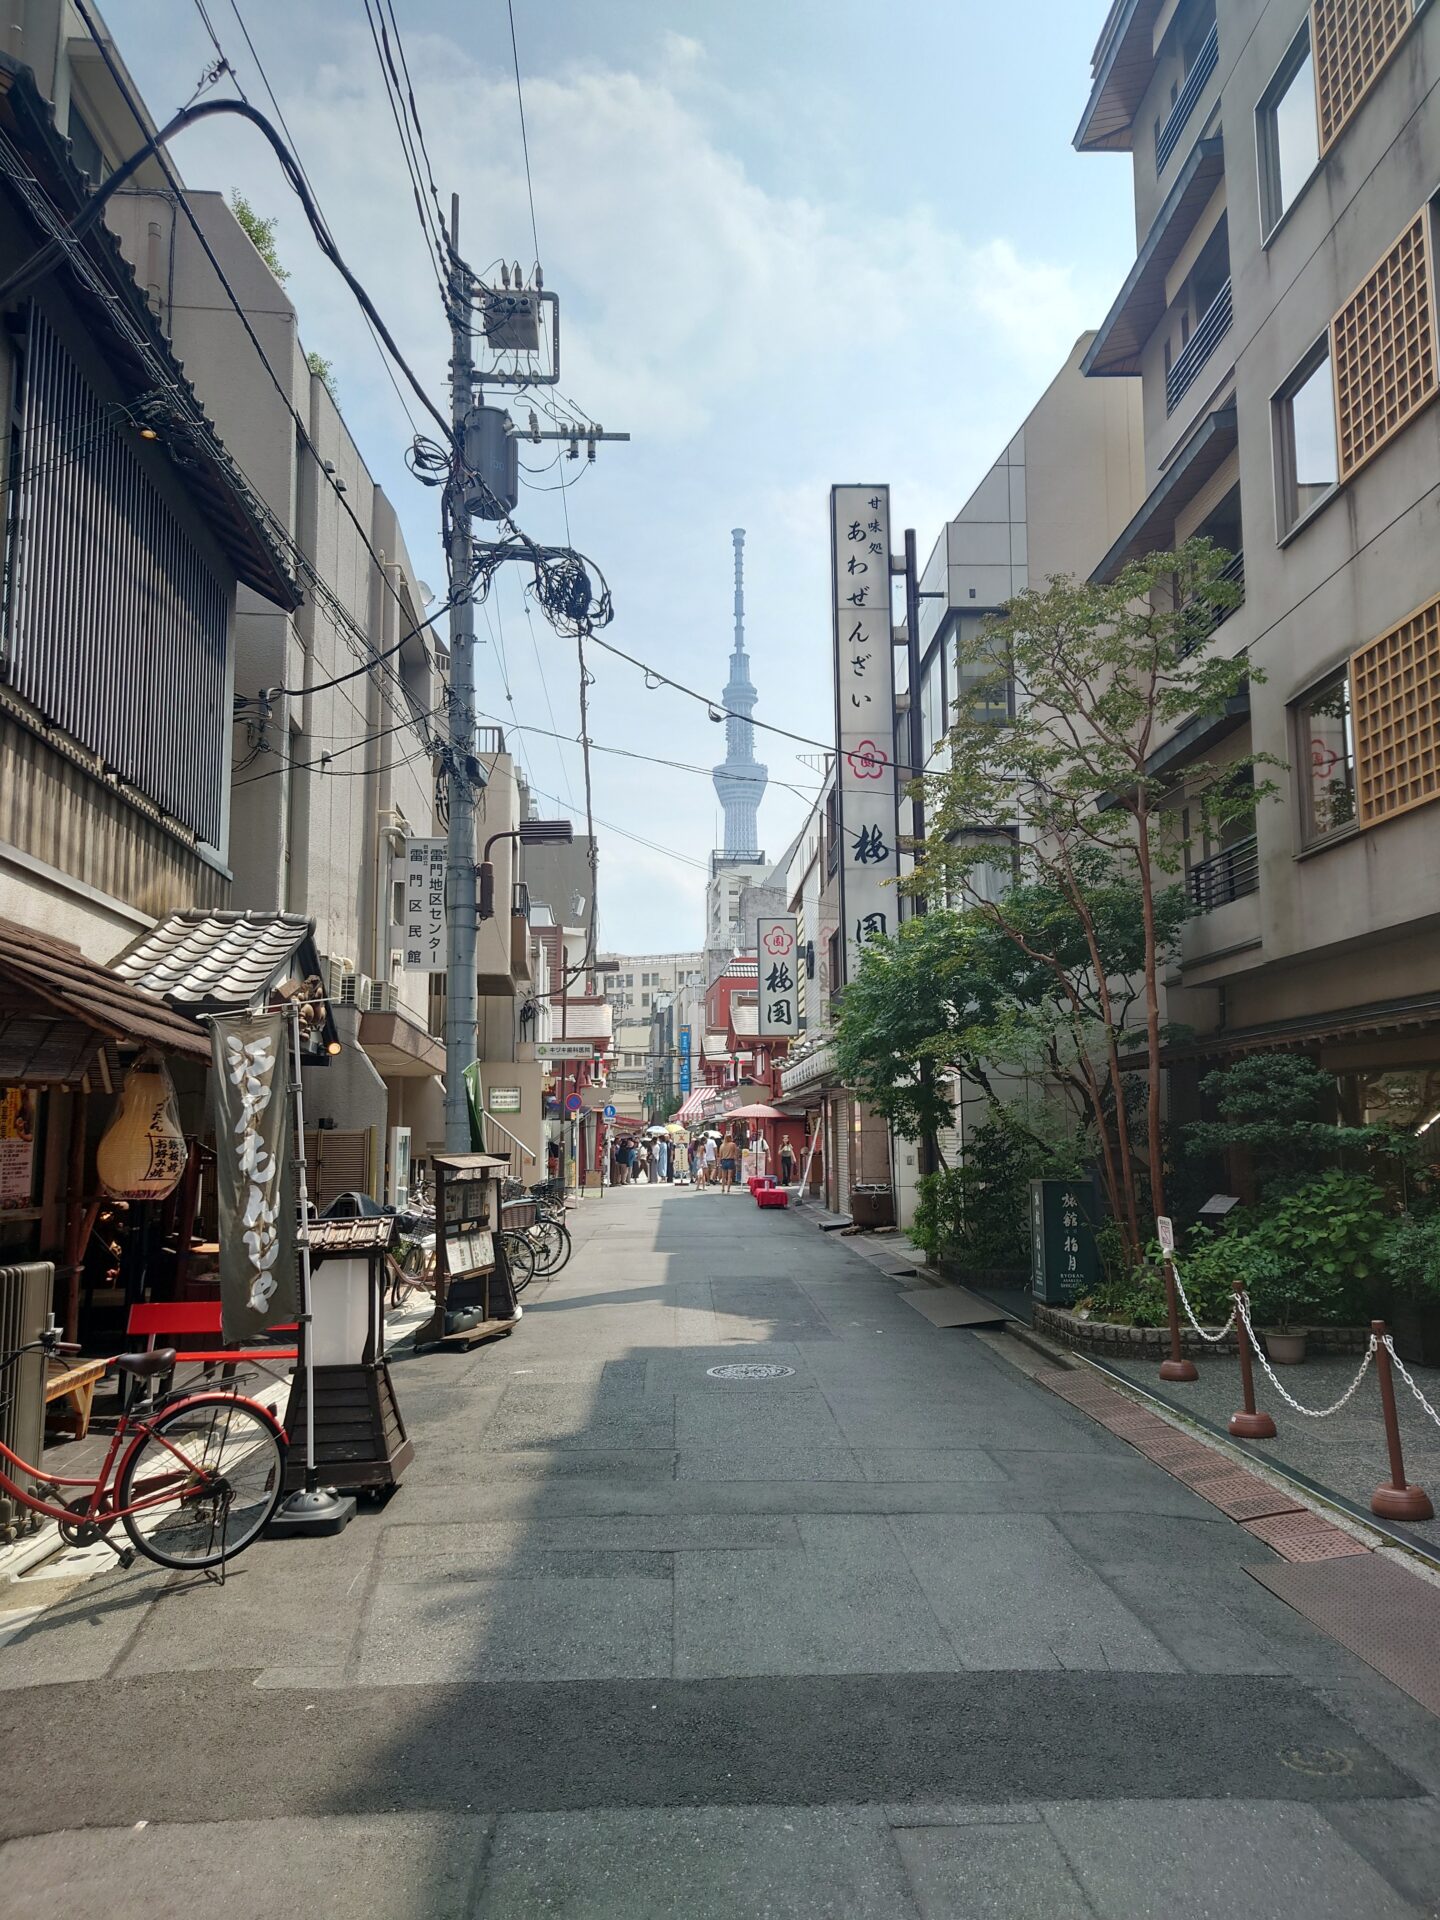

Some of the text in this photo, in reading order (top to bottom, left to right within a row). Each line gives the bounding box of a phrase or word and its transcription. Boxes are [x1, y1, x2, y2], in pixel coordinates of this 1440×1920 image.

[868, 496, 883, 555] 甘味処
[847, 520, 872, 708] あわぜんざい
[407, 848, 423, 964] 雷門区民館
[429, 848, 443, 963] 雷門地区センター
[149, 1138, 168, 1178] お好み焼
[1061, 1193, 1078, 1227] 旅館
